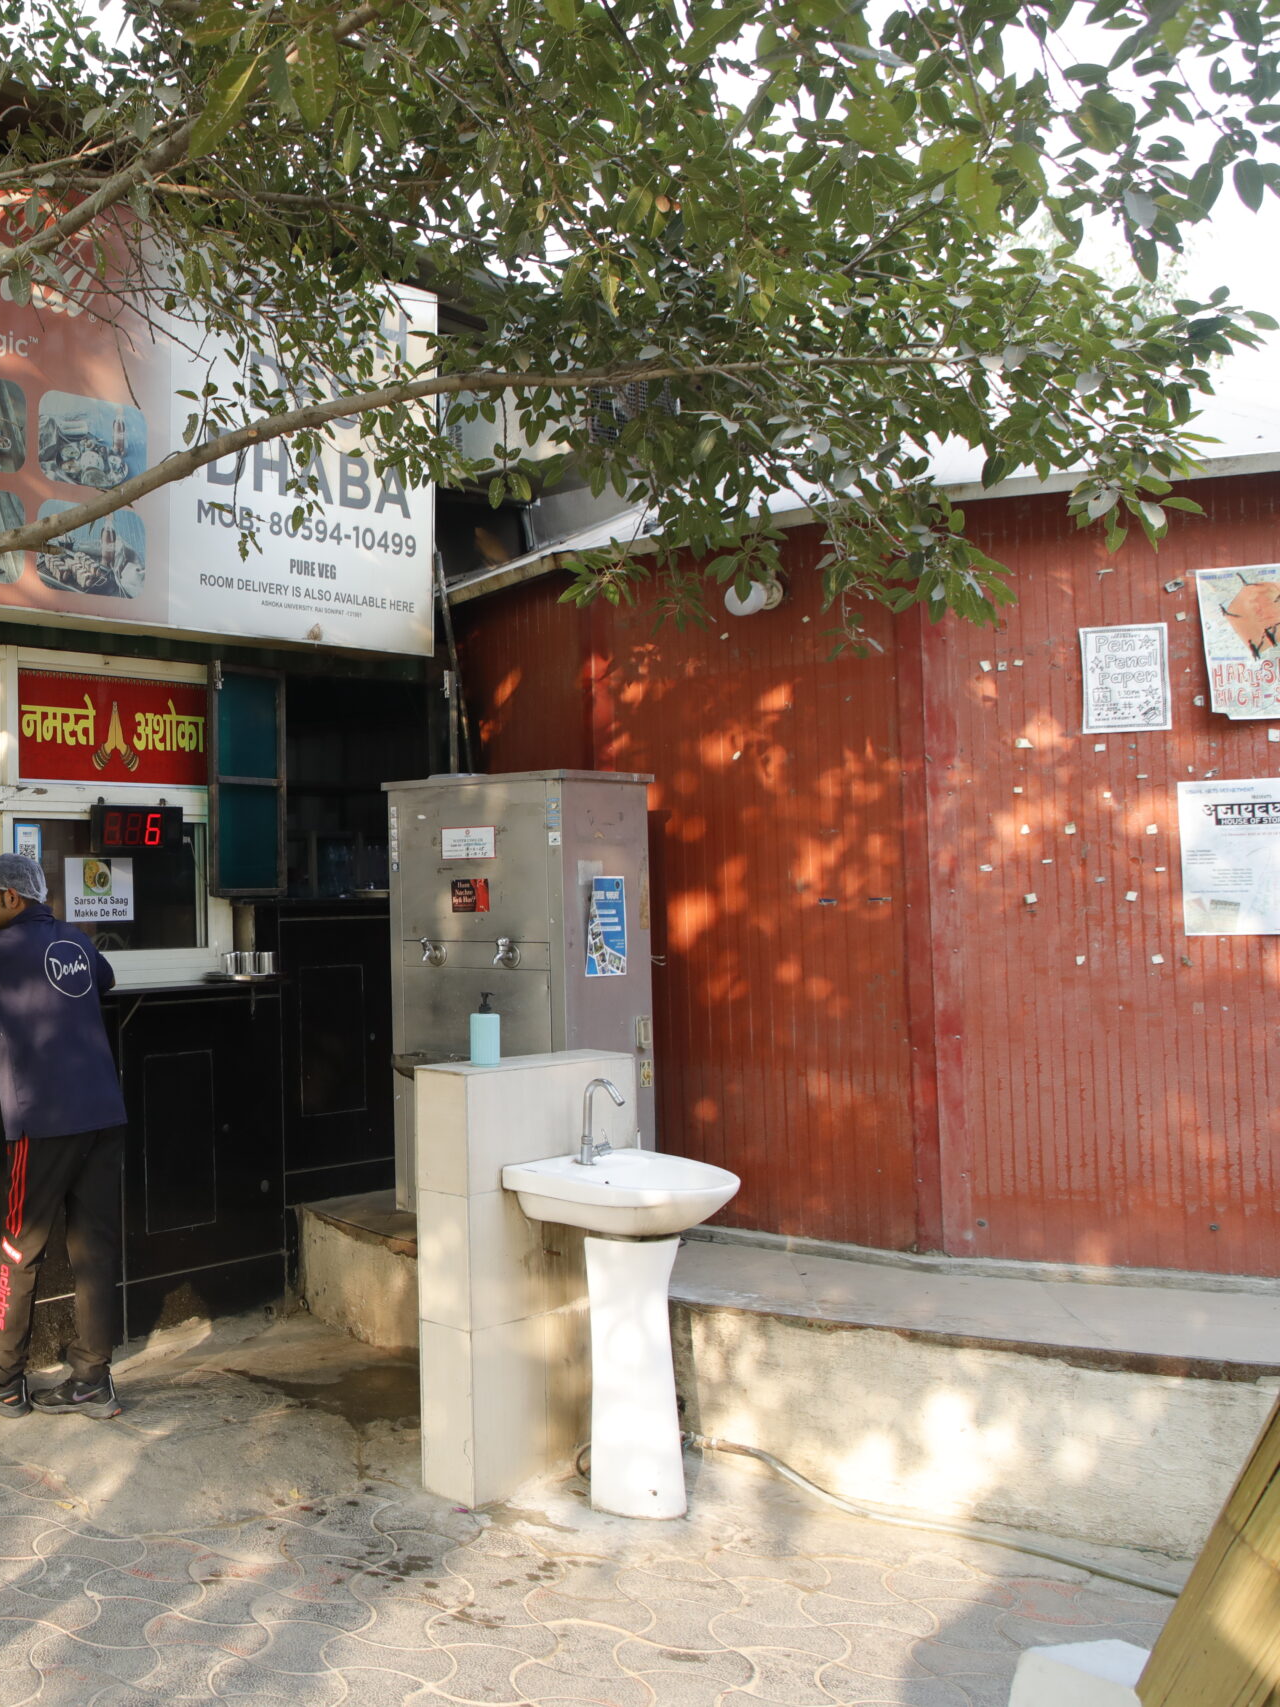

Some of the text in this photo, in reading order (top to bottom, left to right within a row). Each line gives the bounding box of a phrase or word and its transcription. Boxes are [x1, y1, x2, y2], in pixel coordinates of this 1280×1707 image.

[206, 427, 411, 519] DHABA
[196, 498, 417, 558] MOB: 80594-10499
[289, 558, 337, 580] PURE VEG
[199, 573, 415, 613] ROOM DELIVERY IS ALSO AVAILABLE HERE
[261, 600, 283, 609] ASHOKA
[1095, 635, 1136, 653] Pen
[1104, 648, 1158, 669] Pencil
[1098, 670, 1158, 688] Paper
[20, 693, 96, 746] नमस्ते
[132, 698, 205, 753] अशोका
[144, 813, 162, 845] 6
[1221, 818, 1247, 826] HOUSE
[74, 896, 129, 906] Sarso Ka Saag
[74, 908, 128, 917] Makke De Roti
